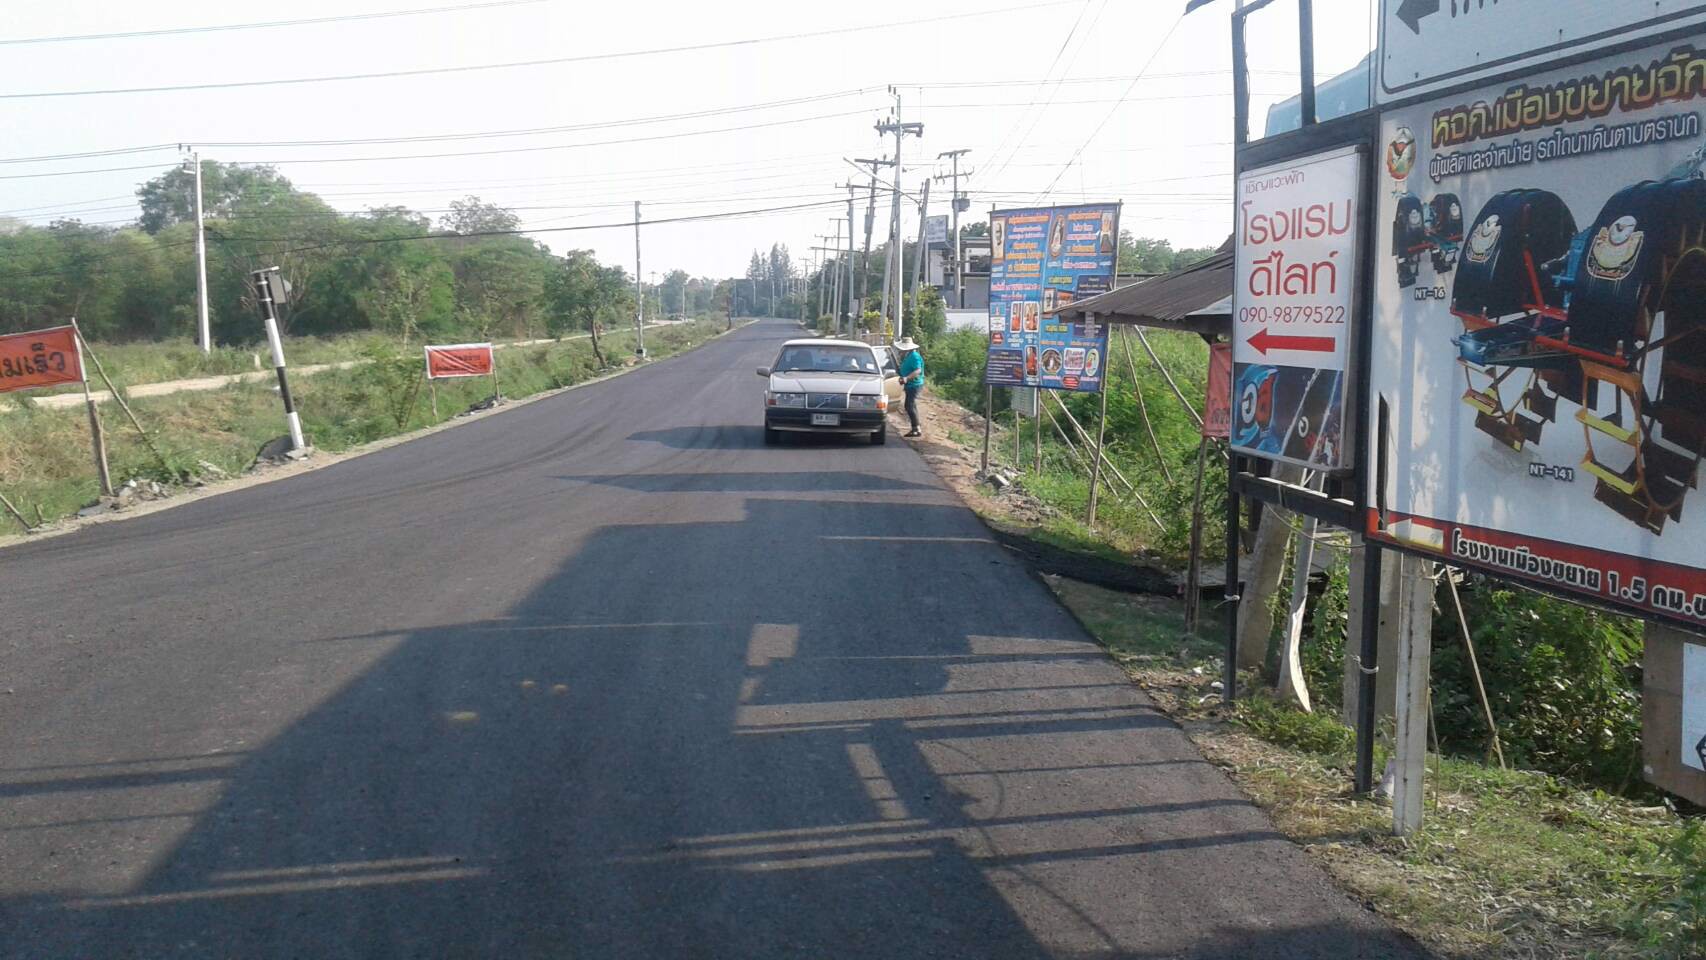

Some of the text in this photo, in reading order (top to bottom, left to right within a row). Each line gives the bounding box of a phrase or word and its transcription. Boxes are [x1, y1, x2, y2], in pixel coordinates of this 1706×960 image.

[1430, 114, 1699, 182] ผู้ผลิตและจำหน่าย รถไถนาเดินตามตรานก
[1245, 170, 1305, 194] เชิญแวะพัก
[1241, 199, 1352, 246] โรงแรม
[1249, 250, 1339, 297] ดีไลท์
[1414, 287, 1446, 300] NT-16
[1239, 306, 1345, 324] 090-9879522
[0, 342, 66, 378] มเร็ว
[1528, 462, 1575, 482] NT-141
[1452, 528, 1601, 592] โรงงานเมืองขยาย
[1608, 570, 1646, 603] 1.5
